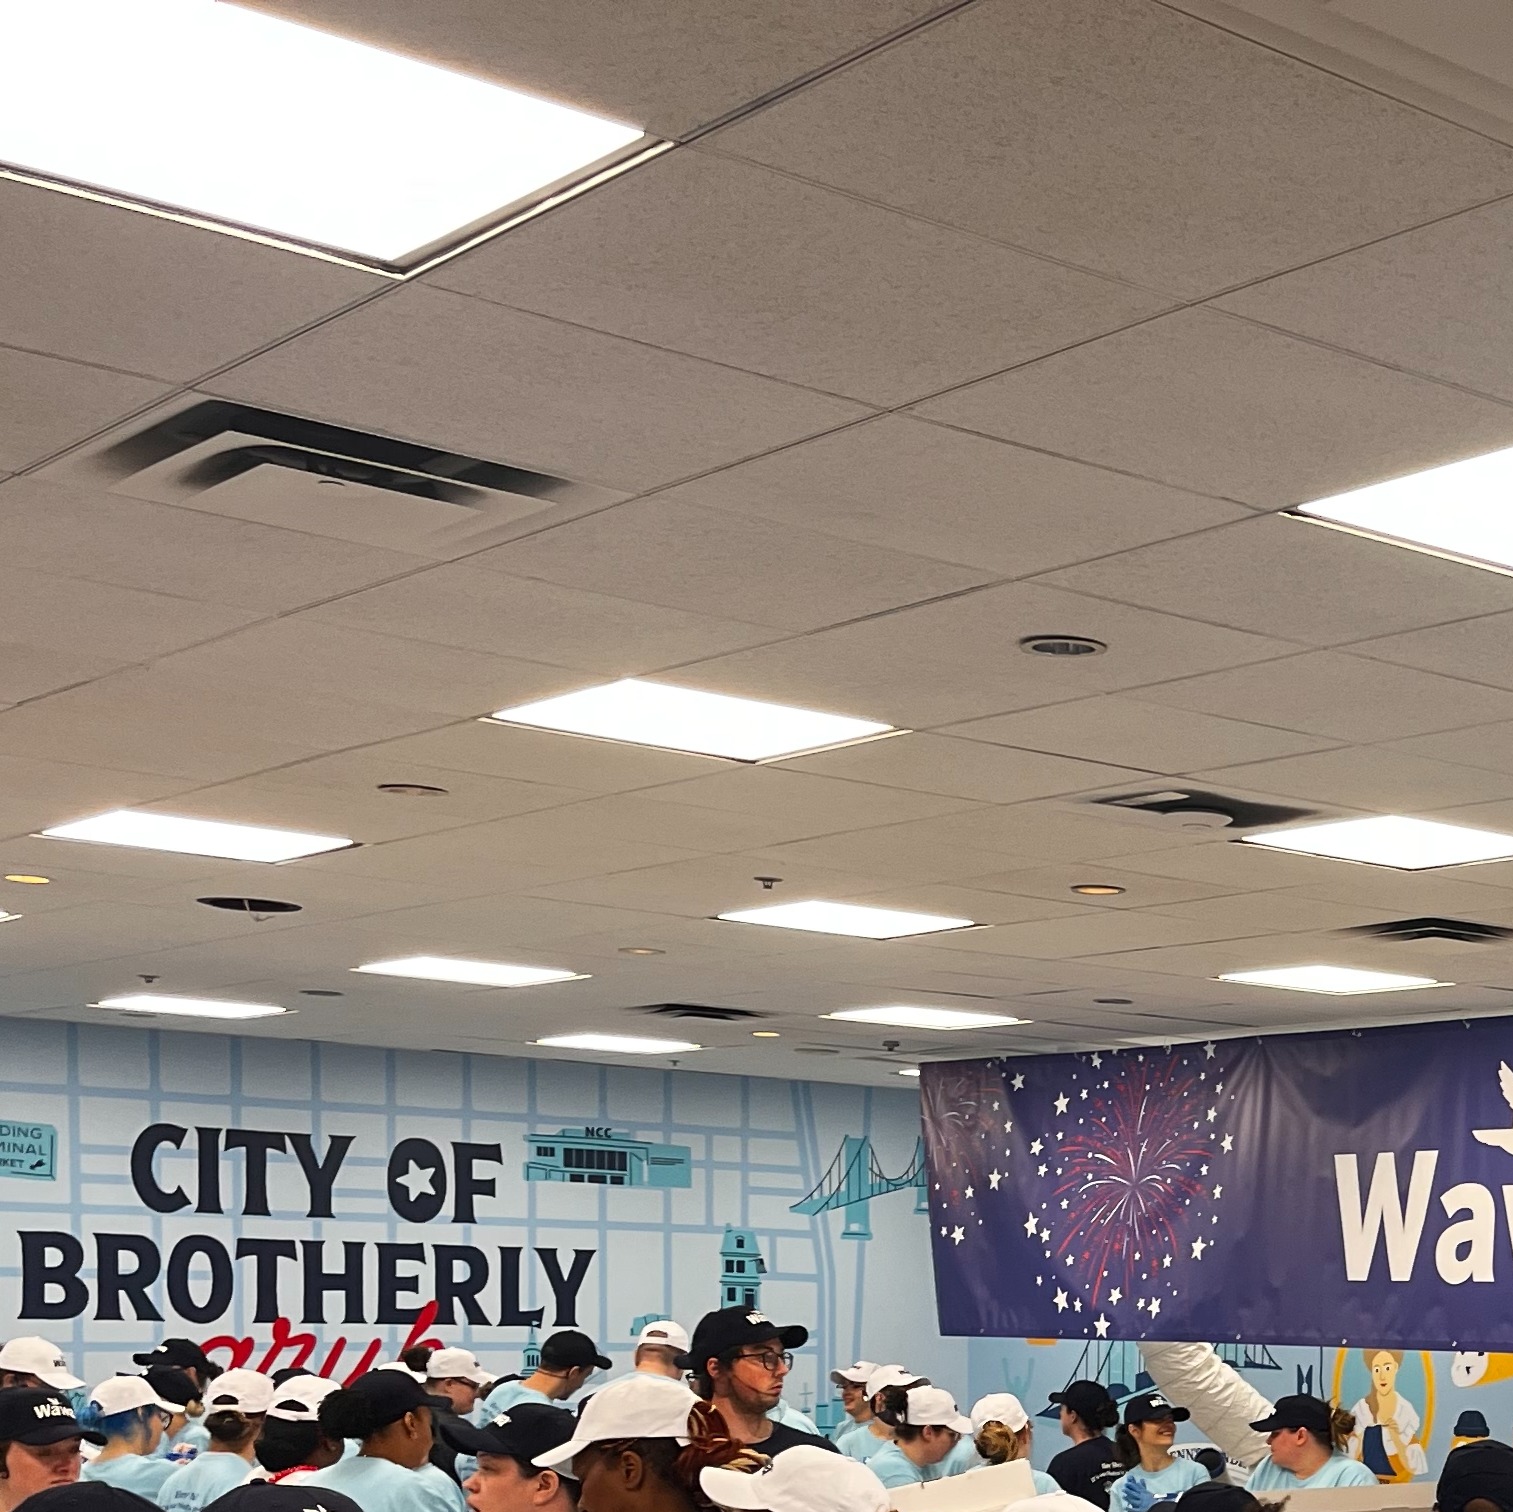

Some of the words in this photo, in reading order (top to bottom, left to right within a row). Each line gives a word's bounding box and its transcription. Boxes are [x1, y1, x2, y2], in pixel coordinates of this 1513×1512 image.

[0, 1124, 42, 1139] DING
[585, 1126, 613, 1138] NCC
[131, 1122, 356, 1218] CITY
[387, 1137, 503, 1224] OF
[17, 1230, 597, 1328] BROTHERLY
